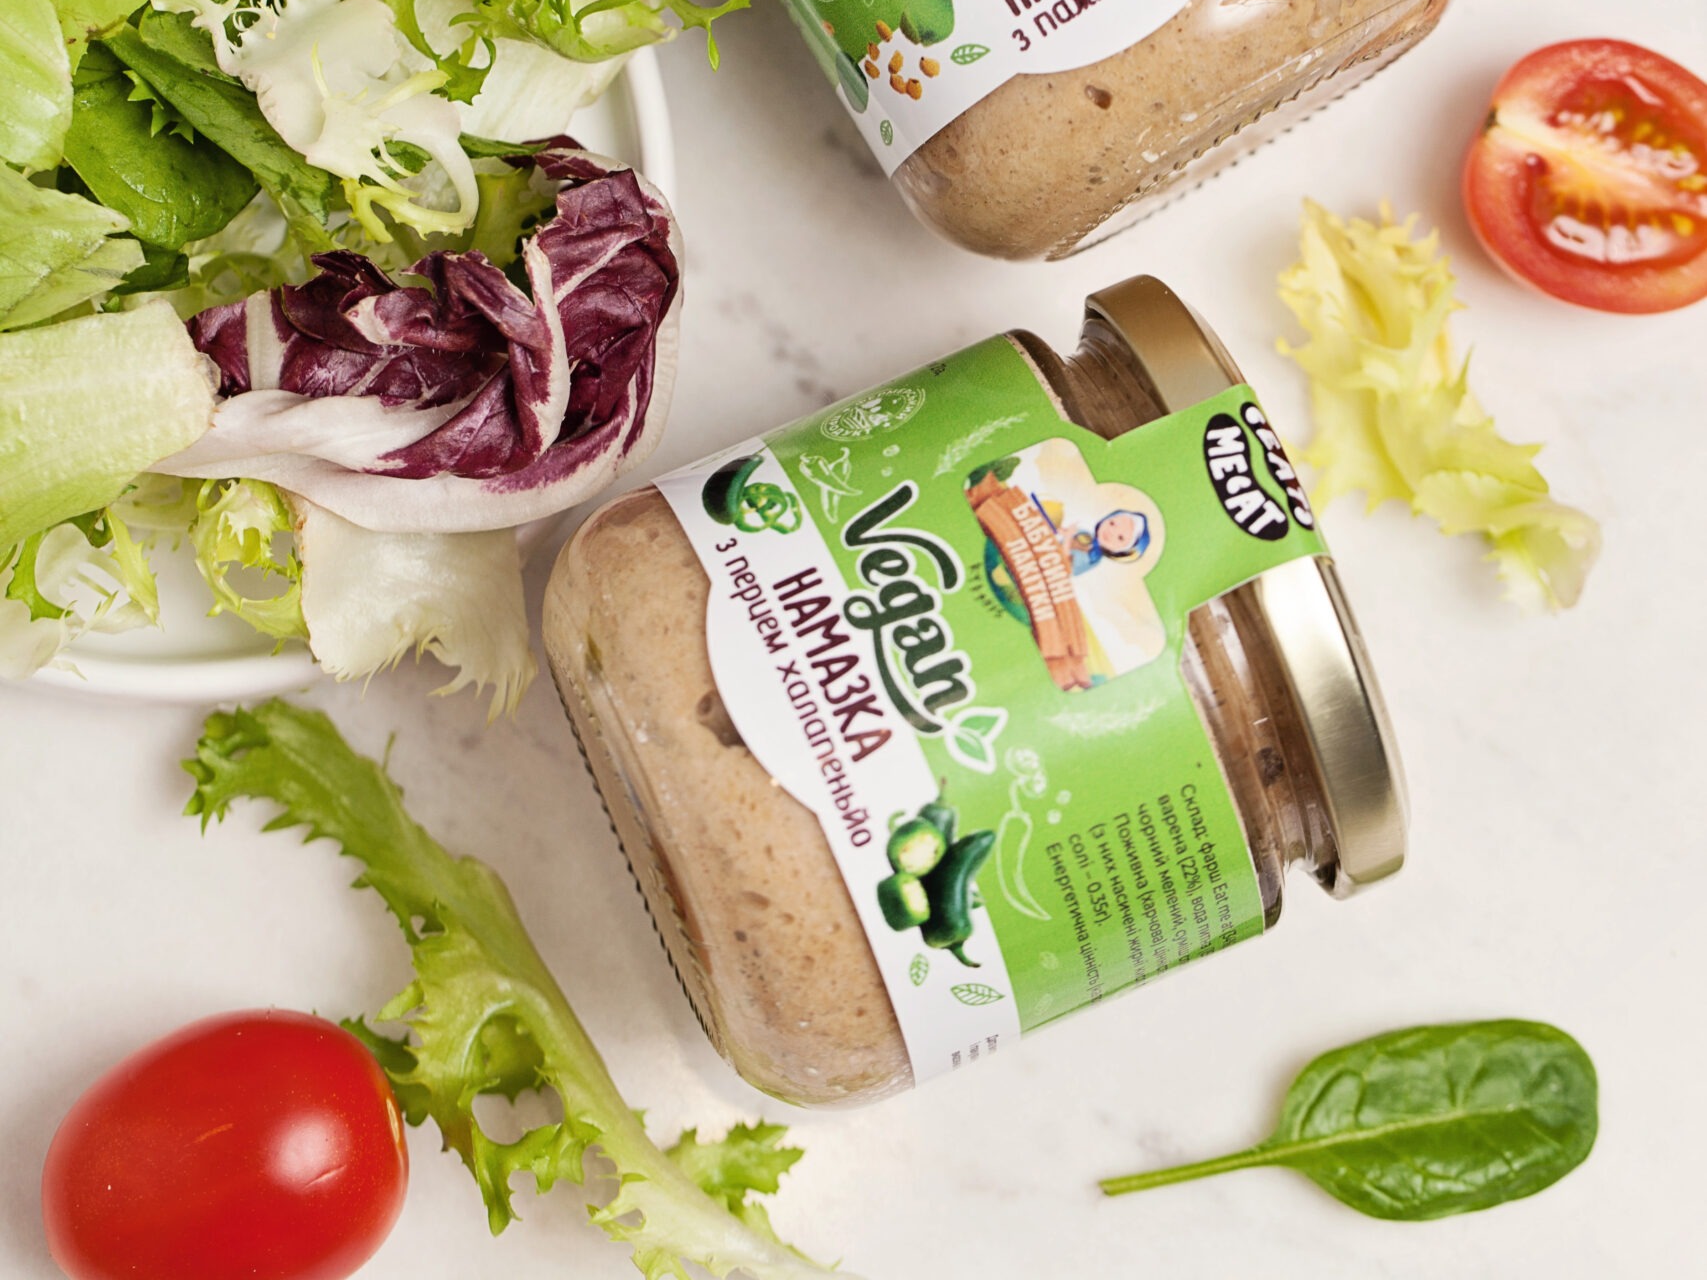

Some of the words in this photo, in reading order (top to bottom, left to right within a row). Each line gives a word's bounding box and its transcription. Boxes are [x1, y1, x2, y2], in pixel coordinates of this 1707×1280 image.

[1005, 537, 1057, 623] ЛАКІТКИ
[1011, 502, 1075, 604] БАБУСИНІ
[843, 484, 969, 734] Vegan
[724, 555, 789, 655] перцем
[776, 659, 872, 849] халапеньйо
[772, 566, 893, 763] НАМАЗКА
[1068, 832, 1093, 869] солі
[1157, 793, 1187, 855] варена
[1176, 855, 1202, 898] (22%),
[1191, 895, 1208, 925] вода
[1180, 783, 1207, 841] Склад:
[1197, 840, 1223, 884] фарш
[1045, 841, 1090, 942] Енергетична
[1079, 941, 1102, 985] цінність
[1097, 841, 1115, 874] них
[1110, 874, 1138, 938] насичені
[1113, 811, 1150, 891] Поживна
[1136, 890, 1167, 947] (харчова)
[1137, 802, 1168, 867] чорний
[1158, 868, 1187, 931] мелений,
[1212, 882, 1229, 904] Eat
[1217, 903, 1231, 921] me
